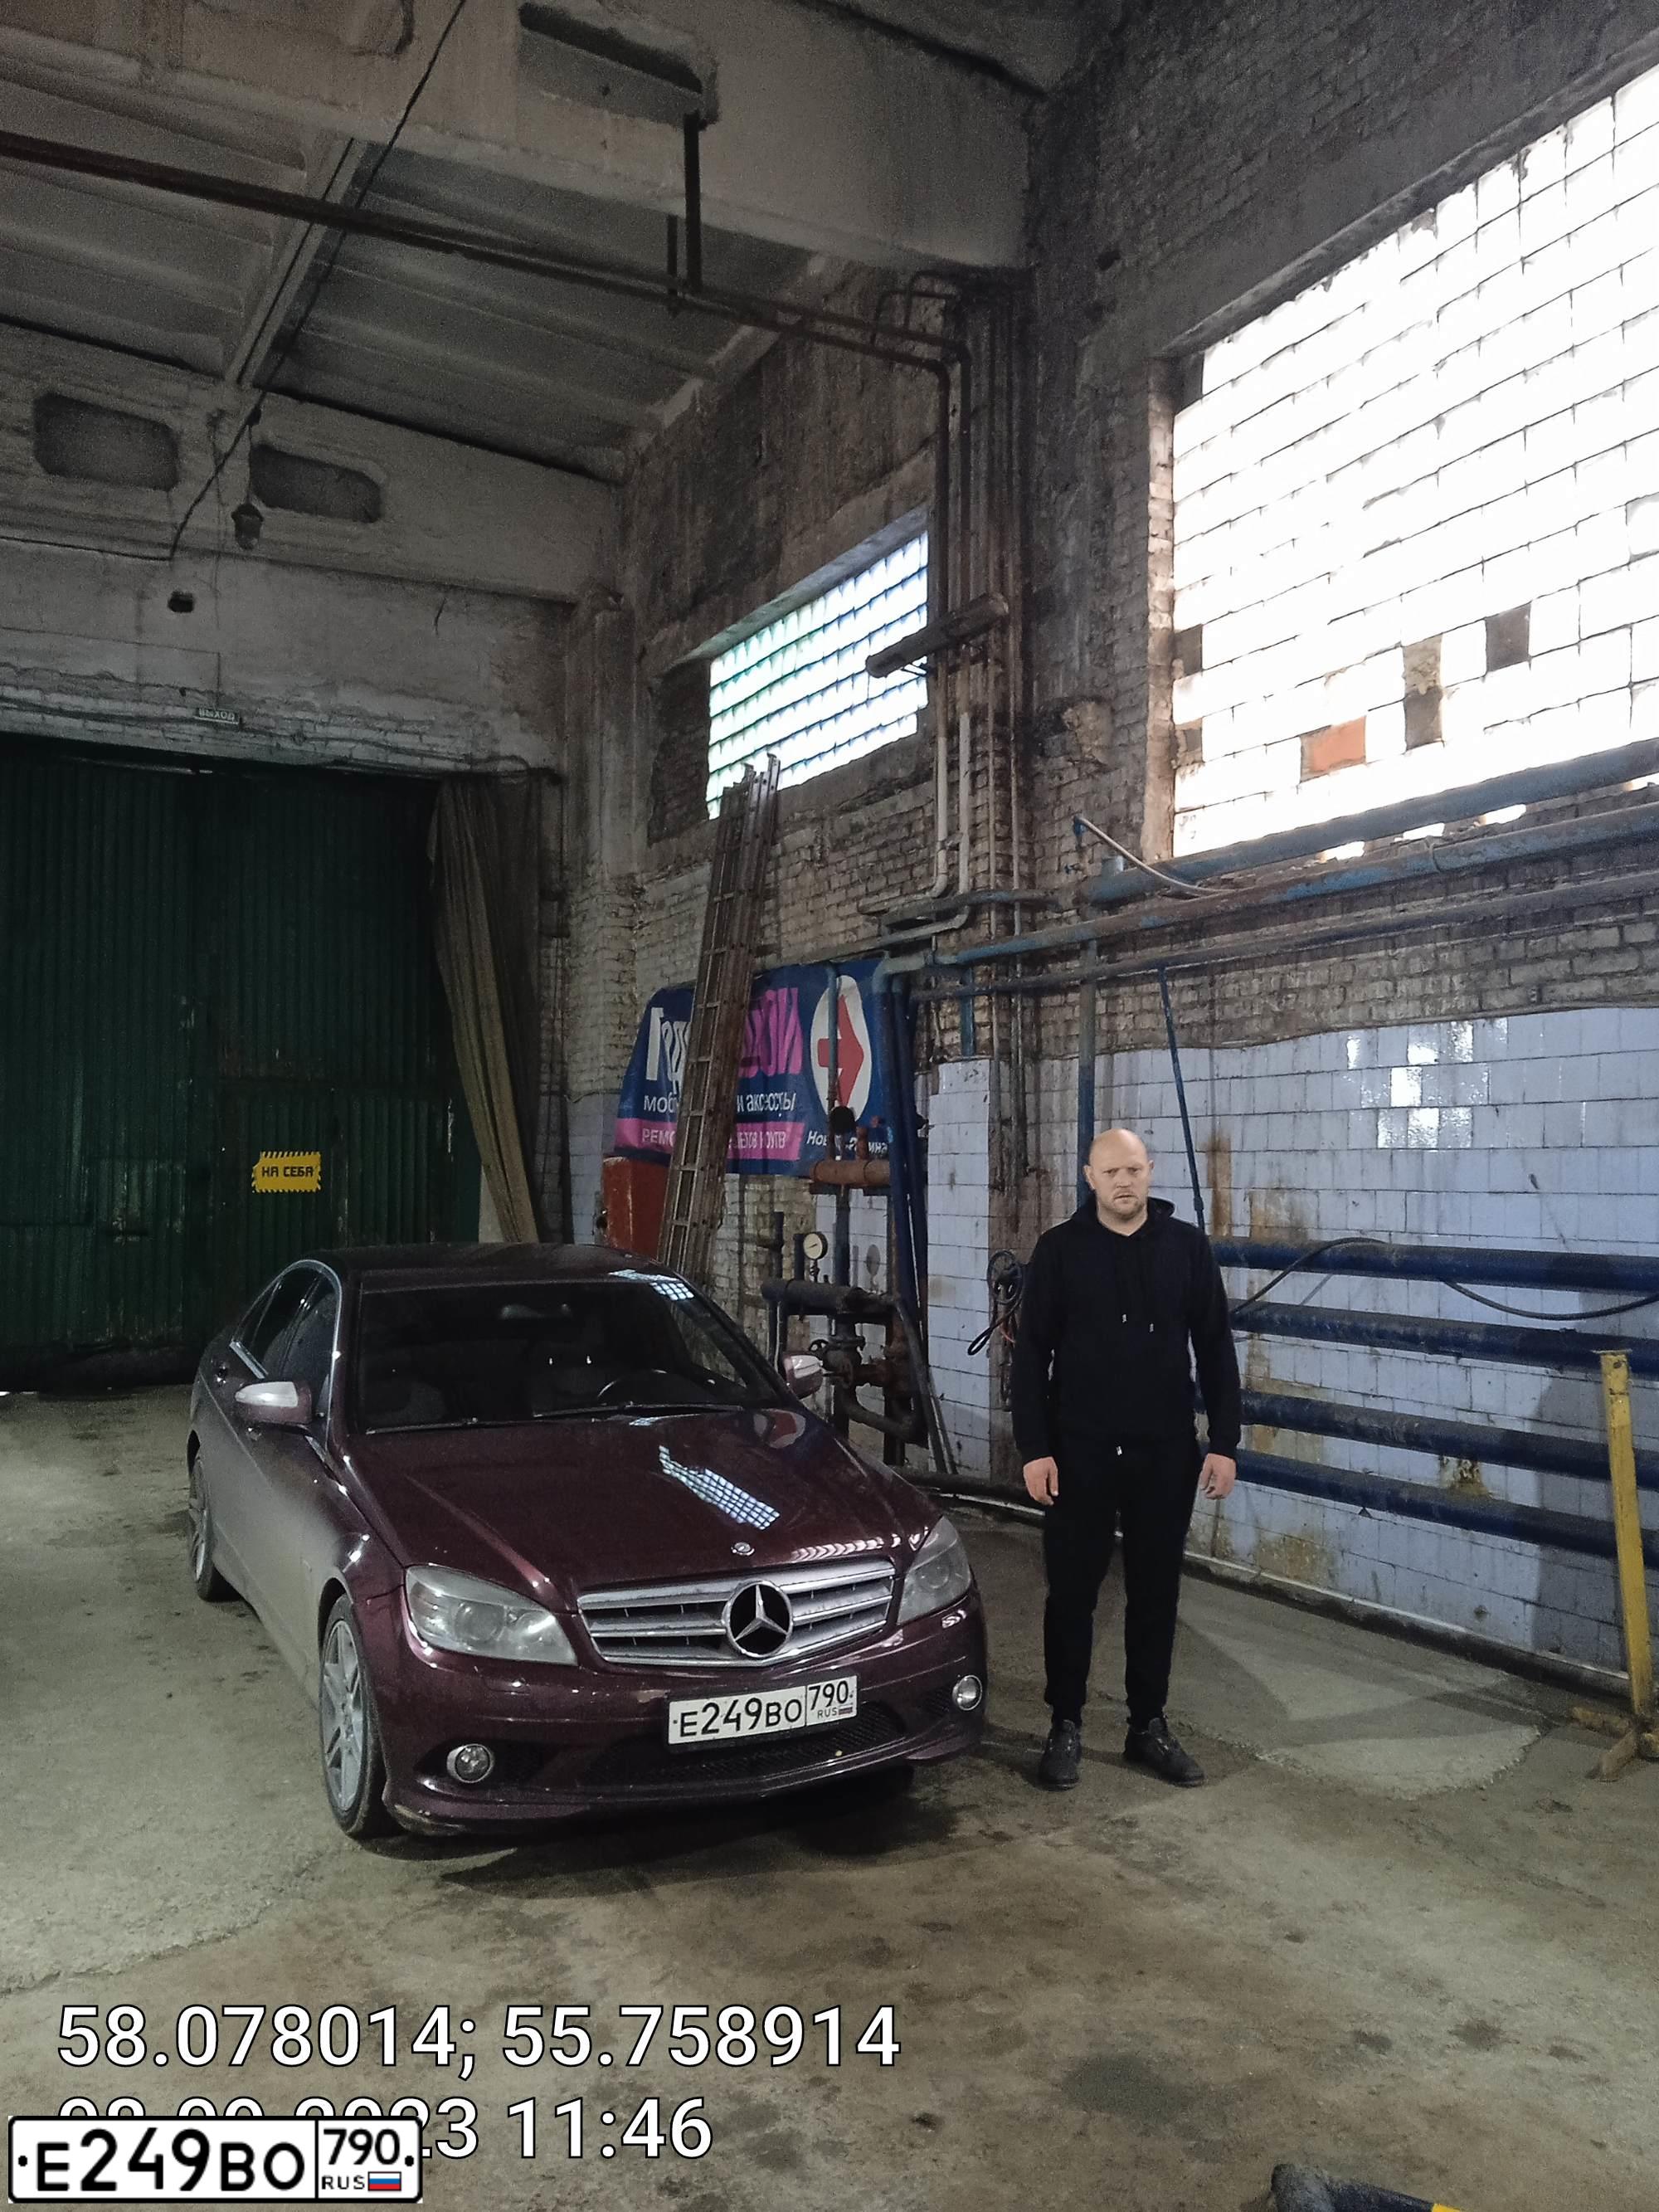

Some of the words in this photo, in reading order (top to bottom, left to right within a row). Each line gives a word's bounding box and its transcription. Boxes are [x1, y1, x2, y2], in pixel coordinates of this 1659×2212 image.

[261, 1166, 279, 1177] НА
[283, 1166, 314, 1177] СЕБЯ
[808, 1680, 849, 1711] 790
[817, 1707, 838, 1720] RUS
